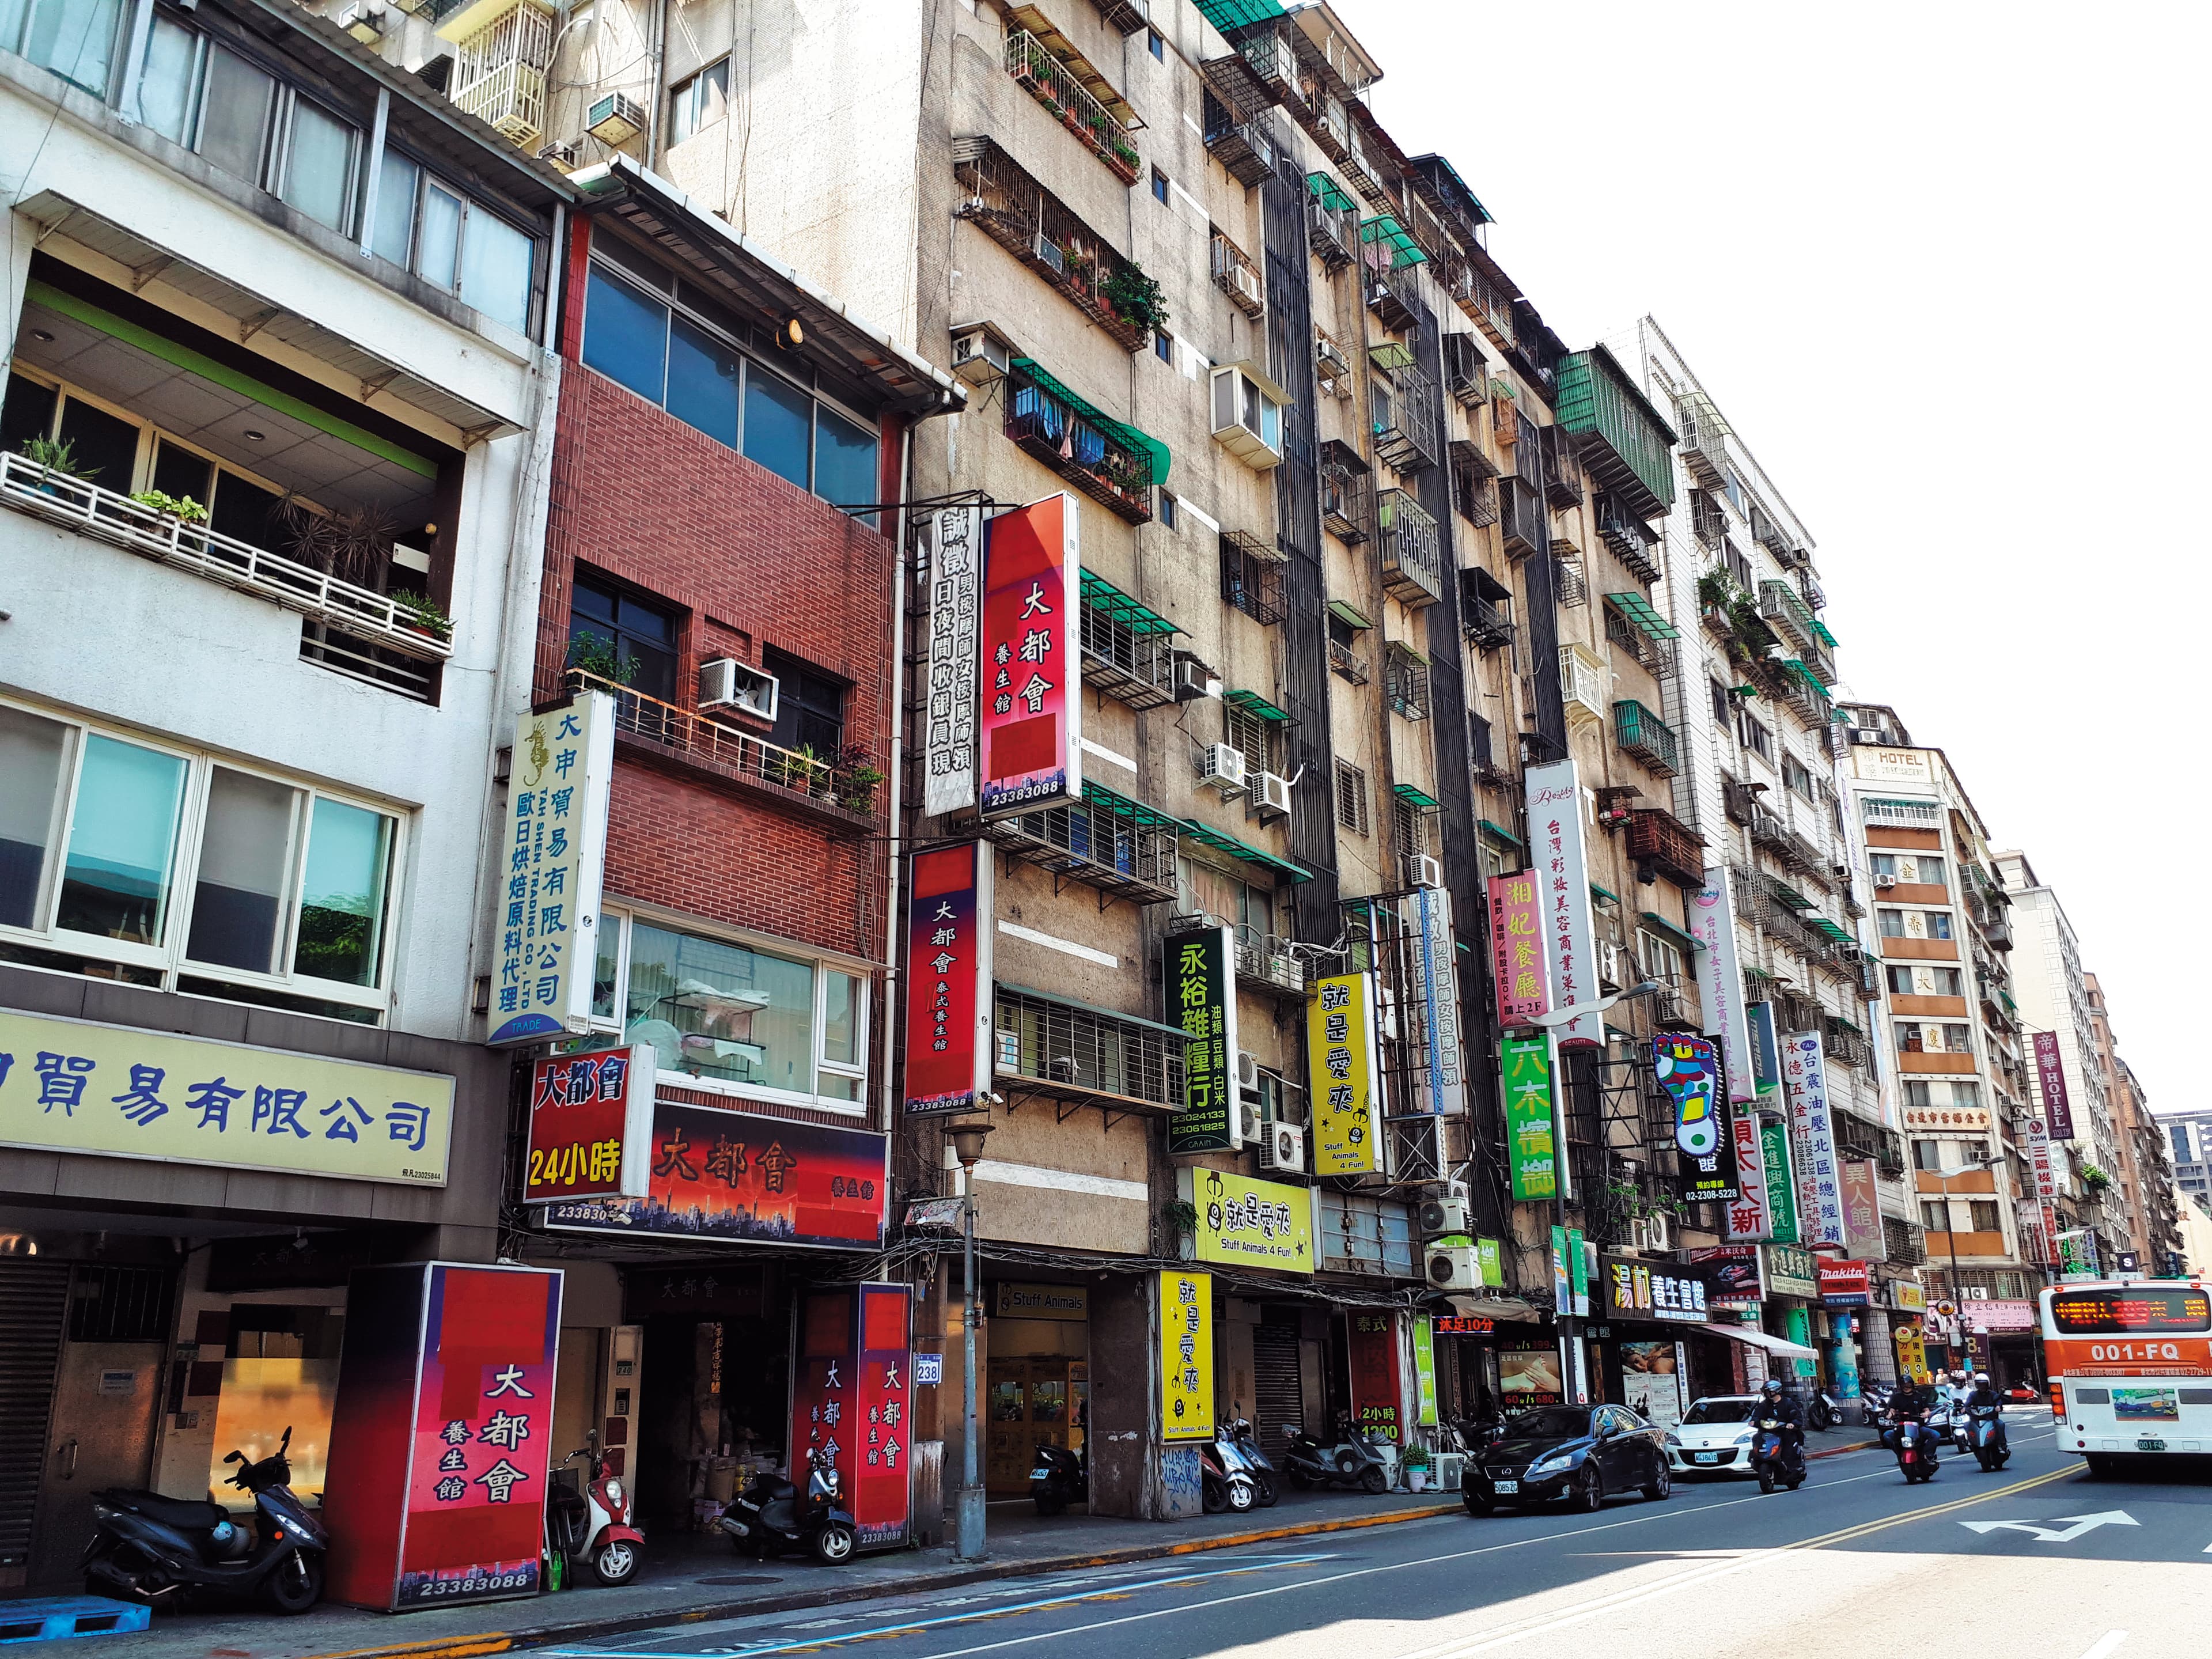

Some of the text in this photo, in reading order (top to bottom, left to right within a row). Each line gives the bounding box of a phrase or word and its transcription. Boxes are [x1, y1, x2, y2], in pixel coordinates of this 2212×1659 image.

[941, 508, 969, 576] 誠徵
[1019, 582, 1054, 714] 大都會
[994, 642, 1013, 715] 養生館
[1879, 752, 1923, 766] HOTEL
[537, 787, 548, 816] TAH
[991, 781, 1058, 807] 23383088
[1529, 785, 1575, 807] Beauty
[533, 823, 544, 863] SHEN
[536, 714, 581, 1006] 大申貿易有限公司
[499, 791, 533, 1013] 歐日烘焙原料代理
[527, 870, 540, 936] TRADING
[929, 900, 957, 975] 大都會
[1506, 882, 1540, 999] 湘妃餐廳
[521, 980, 529, 1009] LTD
[512, 1018, 541, 1033] TRADE
[933, 980, 949, 1052] 泰式養生館
[1179, 942, 1211, 1108] 永裕雜糧行
[1320, 983, 1354, 1113] 就是愛夾
[1751, 1018, 1763, 1078] MERIDA
[0, 1051, 430, 1152] 貿易有限公司
[536, 1056, 627, 1110] 大都會
[1786, 1039, 1810, 1139] 永德五金行
[2046, 1072, 2066, 1127] HOTEL
[911, 1098, 967, 1112] 23383088
[1172, 1110, 1226, 1123] 23024133
[1172, 1122, 1226, 1134] 23061825
[1188, 1139, 1212, 1149] GRAIN
[1324, 1143, 1343, 1151] Stuff
[1804, 1053, 1839, 1241] 台震油壓北區總經銷
[529, 1138, 621, 1186] 24小時
[653, 1127, 797, 1194] 大都會
[1331, 1152, 1359, 1160] Animals
[1796, 1140, 1806, 1176] 23086638
[1805, 1139, 1815, 1175] 23061338
[2032, 1146, 2054, 1195] 三陽機車
[831, 1176, 875, 1200] 養生館
[1685, 1189, 1737, 1200] 02-2308-5228
[1696, 1180, 1725, 1189] 預約專線
[1846, 1164, 1872, 1226] 異人館
[557, 1206, 607, 1221] 233830
[1224, 1191, 1291, 1241] 就是愛夾
[1221, 1238, 1292, 1258] Stuff Animals 4 Fun!
[1691, 1247, 1717, 1259] Milwaukee
[2123, 1257, 2133, 1267] S
[1013, 1292, 1083, 1309] Stuff Animals
[1179, 1278, 1200, 1393] 就是愛夾
[1357, 1316, 1387, 1332] 泰式
[1586, 1327, 1610, 1338] 會館
[2092, 1343, 2179, 1360] 001-FQ
[918, 1366, 937, 1379] 238
[475, 1363, 534, 1502] 大都會
[821, 1359, 843, 1469] 大都會
[881, 1361, 902, 1468] 大都會
[1362, 1407, 1395, 1421] 2小時
[867, 1406, 880, 1465] 養生館
[435, 1421, 471, 1501] 養生館
[862, 1531, 902, 1544] 23383088
[419, 1574, 528, 1597] 23383088
